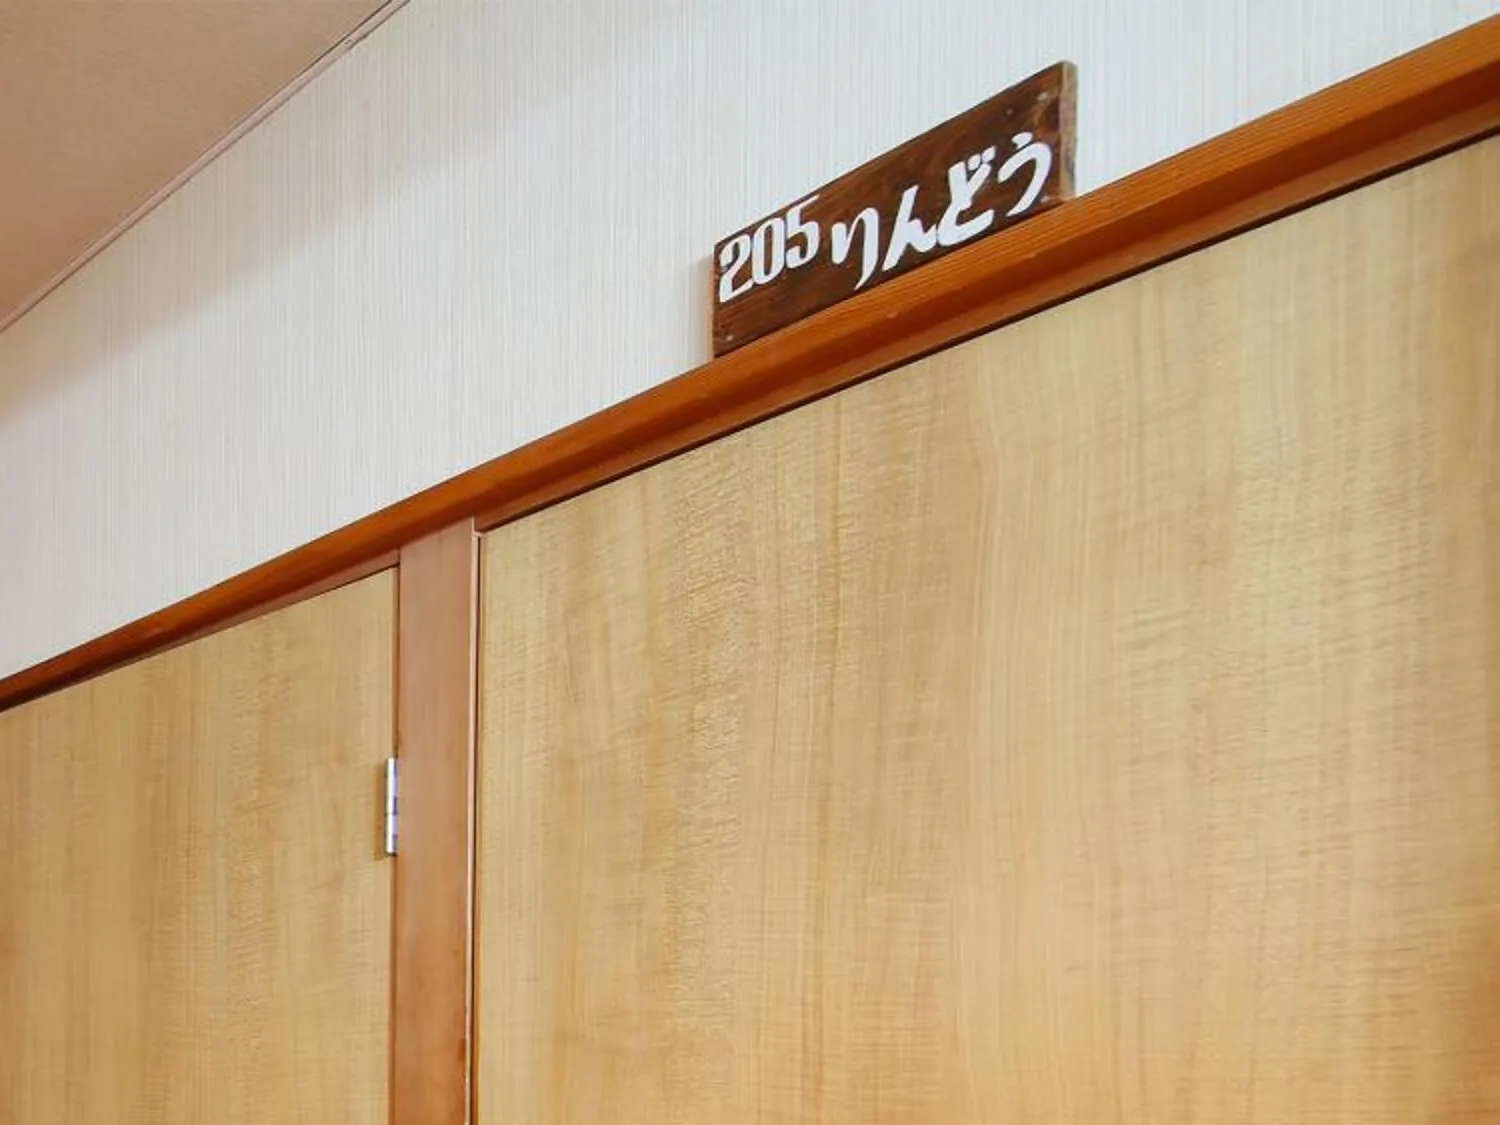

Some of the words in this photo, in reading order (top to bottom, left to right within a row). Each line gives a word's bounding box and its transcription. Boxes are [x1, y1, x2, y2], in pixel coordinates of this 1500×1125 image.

[719, 195, 820, 303] 205
[831, 132, 1052, 290] りんどう
